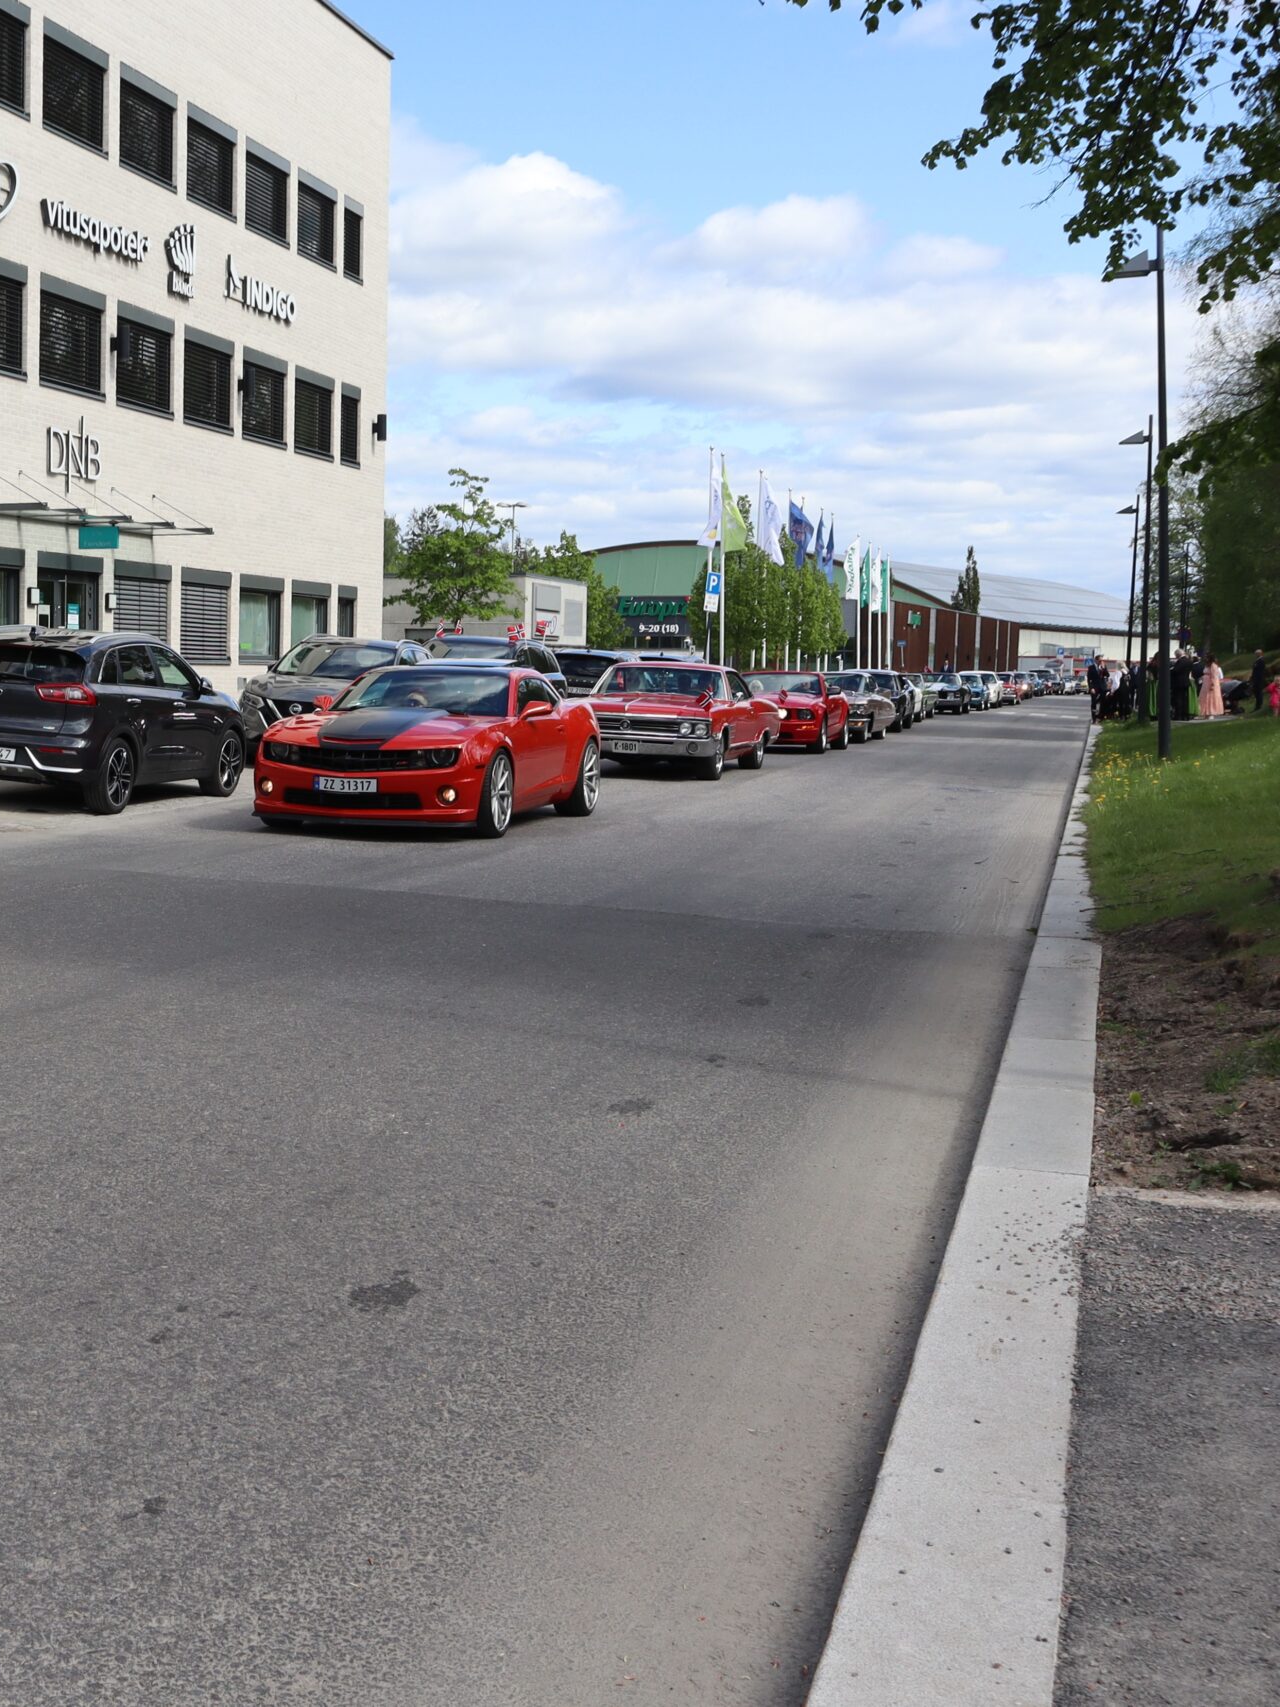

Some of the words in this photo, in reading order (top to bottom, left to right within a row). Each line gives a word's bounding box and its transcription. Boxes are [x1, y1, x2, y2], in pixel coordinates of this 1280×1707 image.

[44, 198, 145, 261] vitusapotek
[244, 276, 296, 321] INDIGO
[48, 415, 102, 494] DNB
[709, 575, 718, 592] P
[618, 596, 689, 621] Europri
[661, 623, 680, 634] (18)
[613, 741, 638, 752] K-1801
[323, 778, 336, 790] ZZ
[339, 779, 372, 791] 31317
